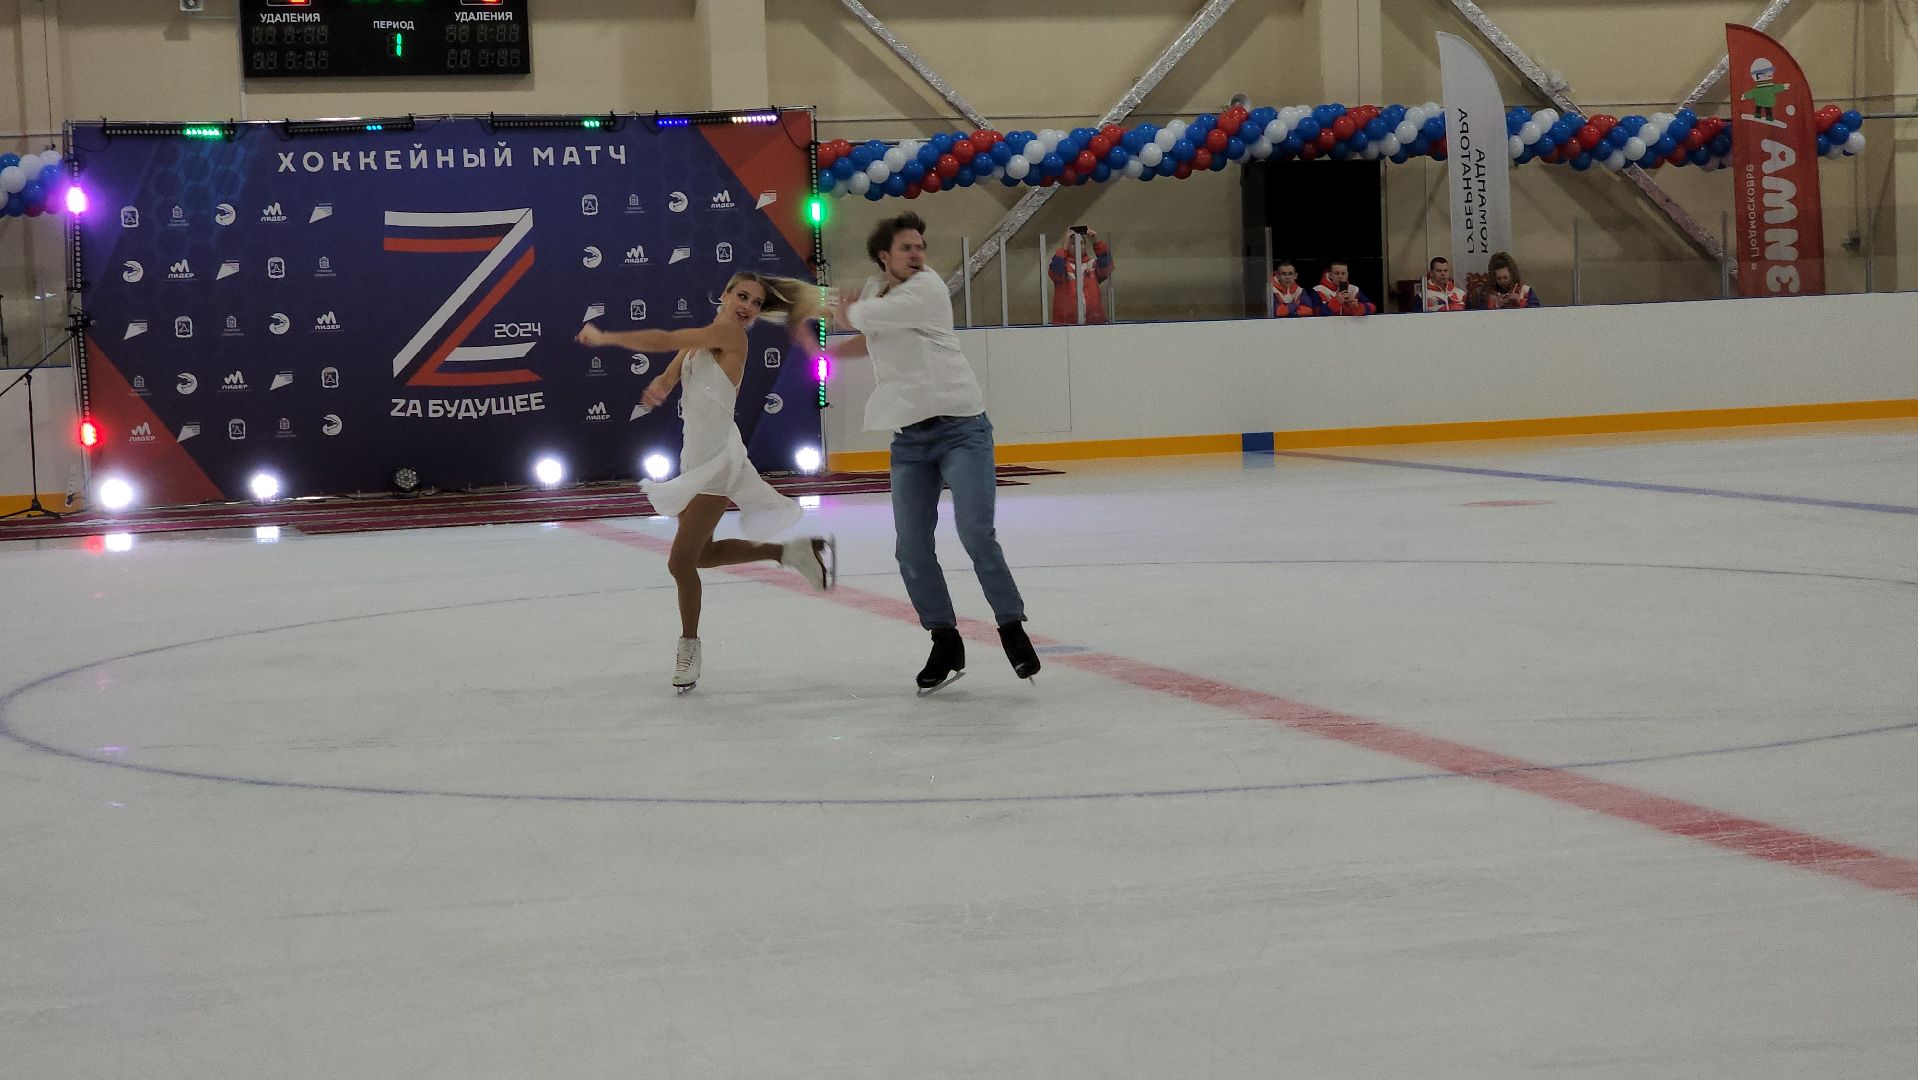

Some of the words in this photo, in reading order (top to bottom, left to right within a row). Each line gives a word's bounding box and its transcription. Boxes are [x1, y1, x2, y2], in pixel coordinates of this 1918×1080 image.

[260, 13, 321, 23] УДАЛЕНИЯ
[455, 11, 513, 22] УДАЛЕНИЯ
[373, 20, 414, 30] ПЕРИОД
[396, 33, 402, 56] 1
[277, 141, 513, 173] ХОККЕЙНЫЙ
[533, 145, 627, 167] МАТЧ
[494, 322, 542, 338] 2024
[428, 391, 546, 420] БУДУЩЕЕ
